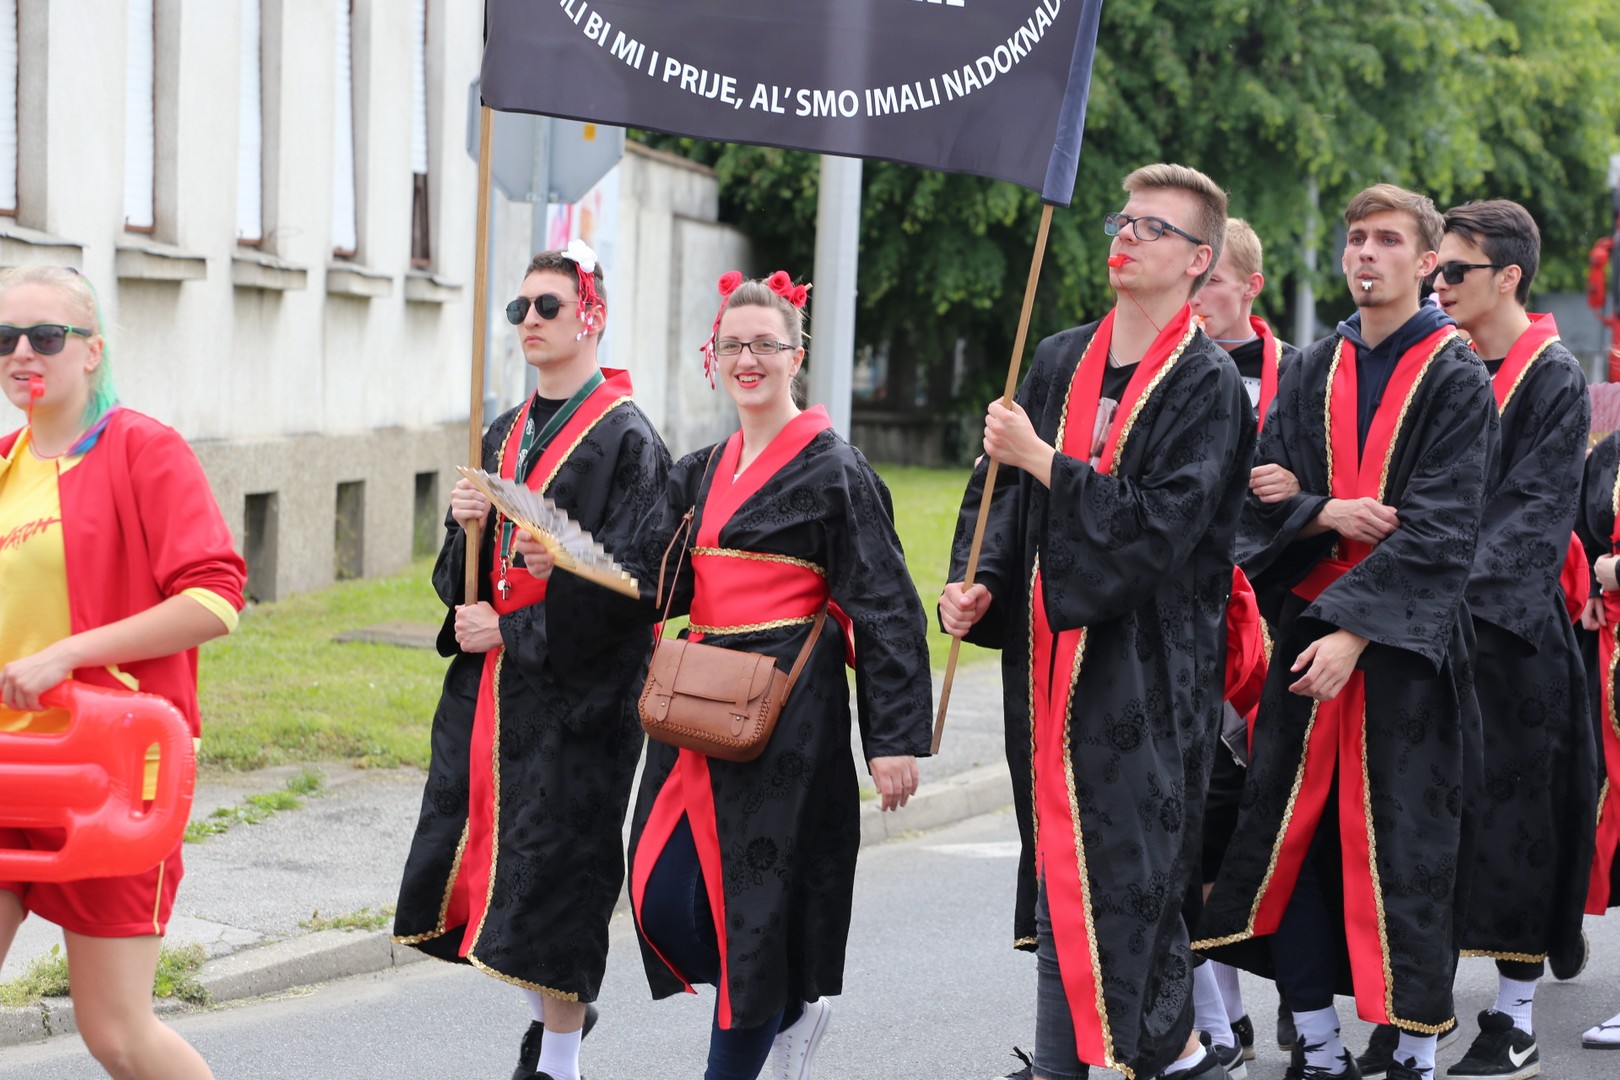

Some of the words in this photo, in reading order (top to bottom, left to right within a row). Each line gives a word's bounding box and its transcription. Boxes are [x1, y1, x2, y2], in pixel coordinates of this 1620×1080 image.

[560, 0, 588, 26] LI
[583, 10, 612, 48] BI
[609, 30, 646, 70] MI
[647, 50, 659, 77] I
[662, 56, 744, 110] PRIJE,
[795, 88, 859, 118] SMO
[865, 77, 941, 117] IMALI
[941, 0, 1065, 101] NADOKNAD
